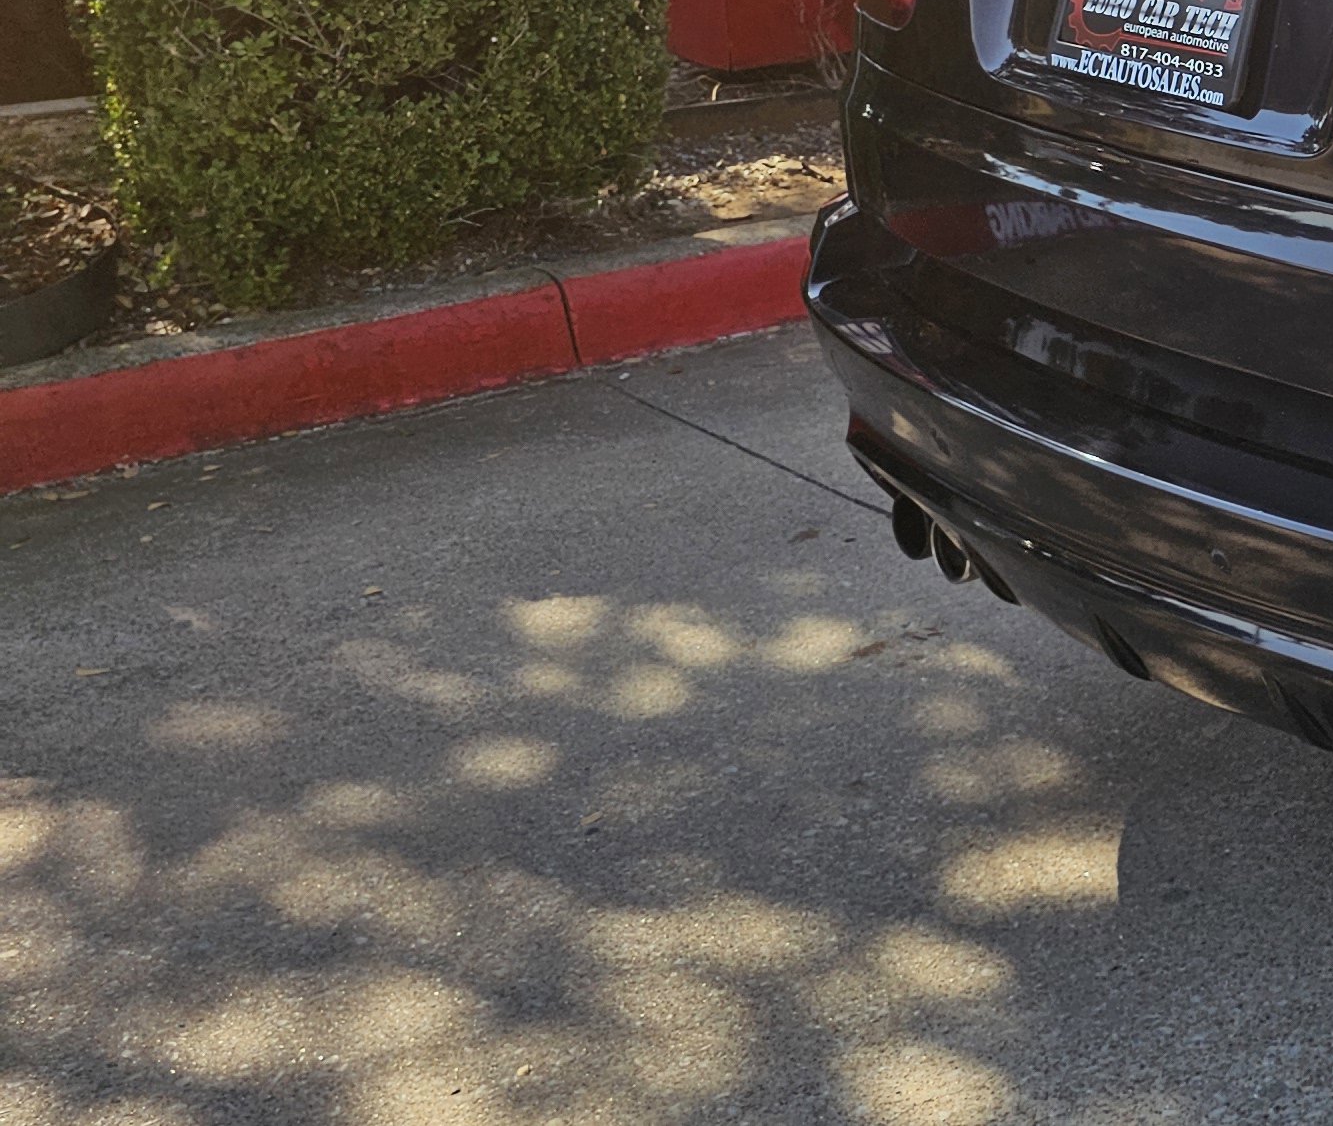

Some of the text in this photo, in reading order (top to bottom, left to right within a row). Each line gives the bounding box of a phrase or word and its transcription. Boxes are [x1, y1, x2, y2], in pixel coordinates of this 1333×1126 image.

[1123, 22, 1229, 53] european automotive
[1180, 5, 1240, 41] TECH
[1051, 50, 1224, 106] www.ECTAUTOSALES.com
[1120, 43, 1224, 78] 817-404-4033
